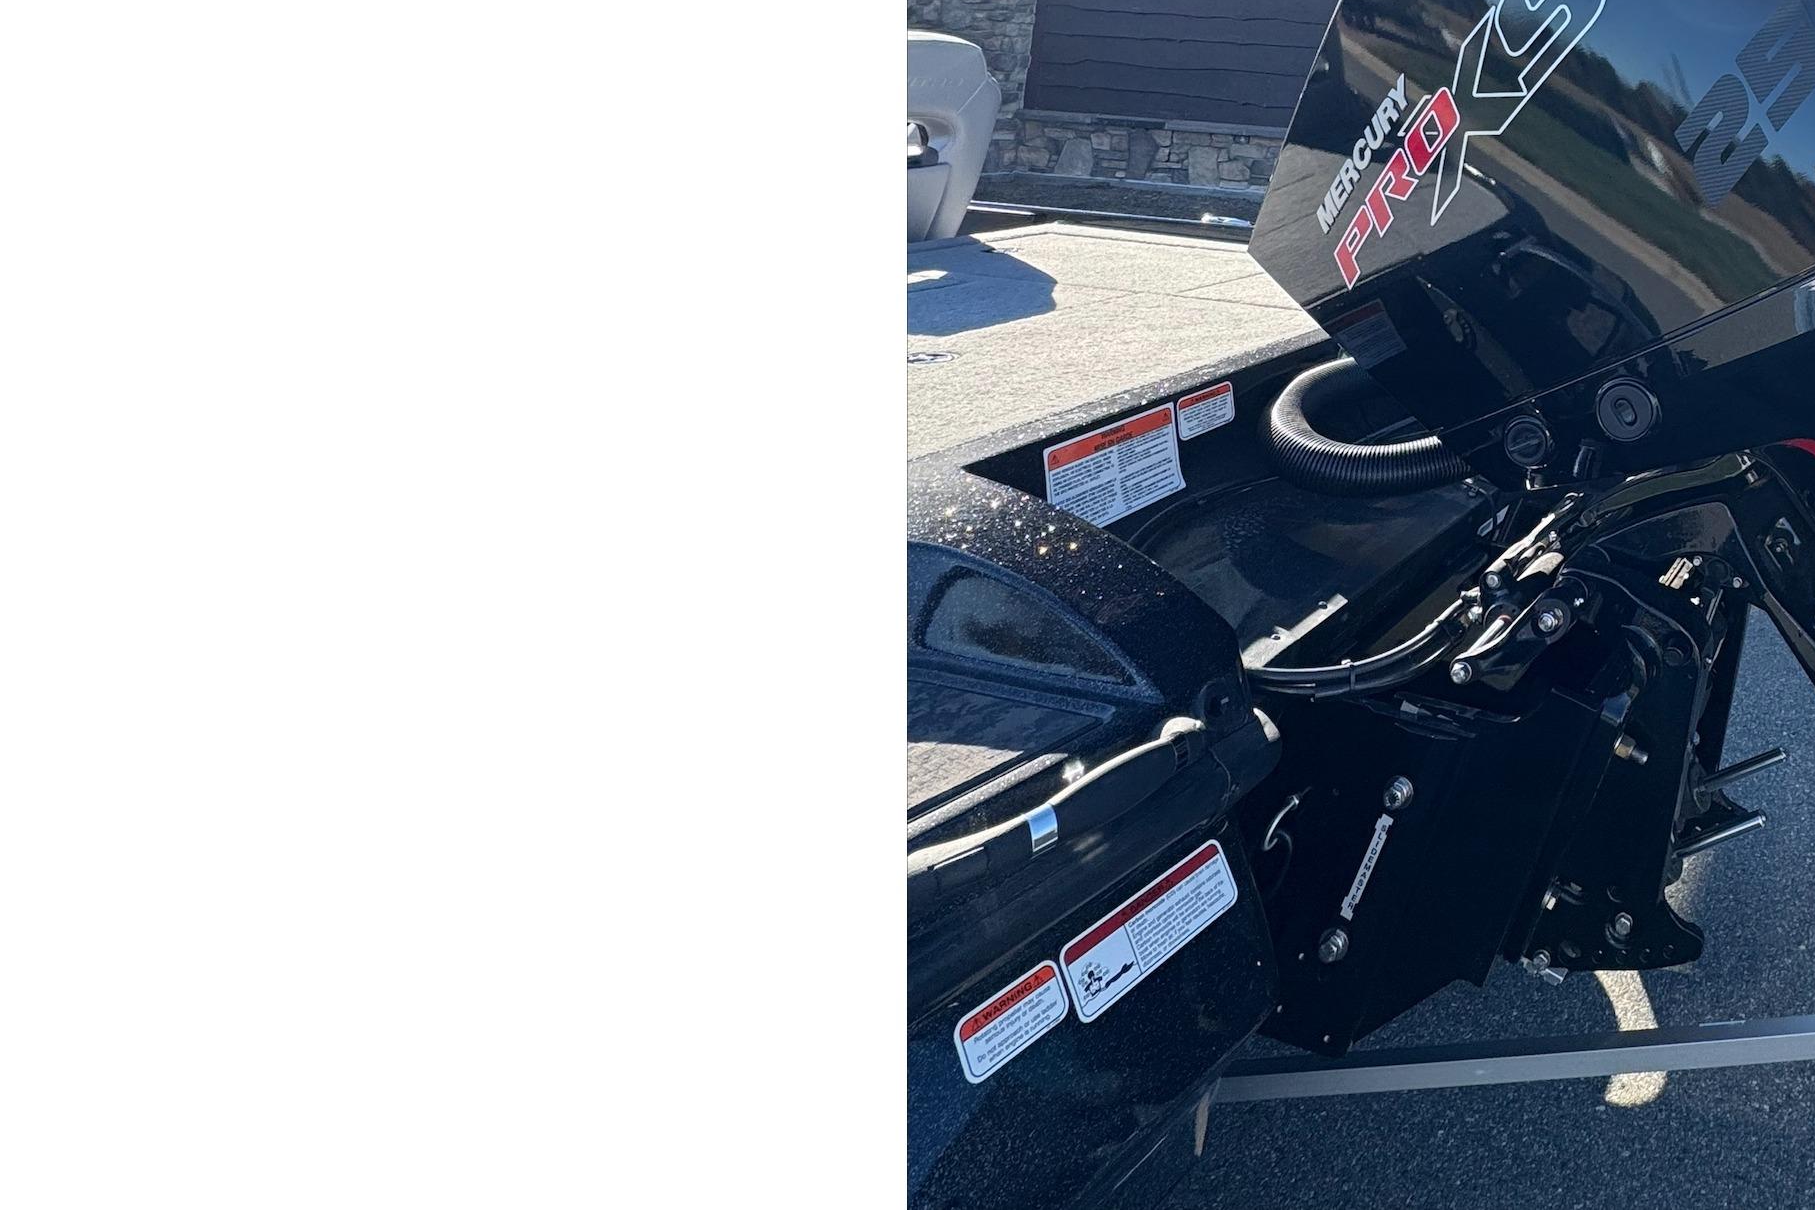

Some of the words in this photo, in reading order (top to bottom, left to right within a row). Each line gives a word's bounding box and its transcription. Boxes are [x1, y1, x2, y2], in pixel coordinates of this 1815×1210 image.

[1316, 73, 1410, 235] MERCURY
[1334, 86, 1461, 291] PRO
[1347, 824, 1387, 910] SLIDEMASTER
[983, 983, 1031, 1020] WARNING
[977, 1052, 986, 1062] Do
[987, 1045, 996, 1055] not
